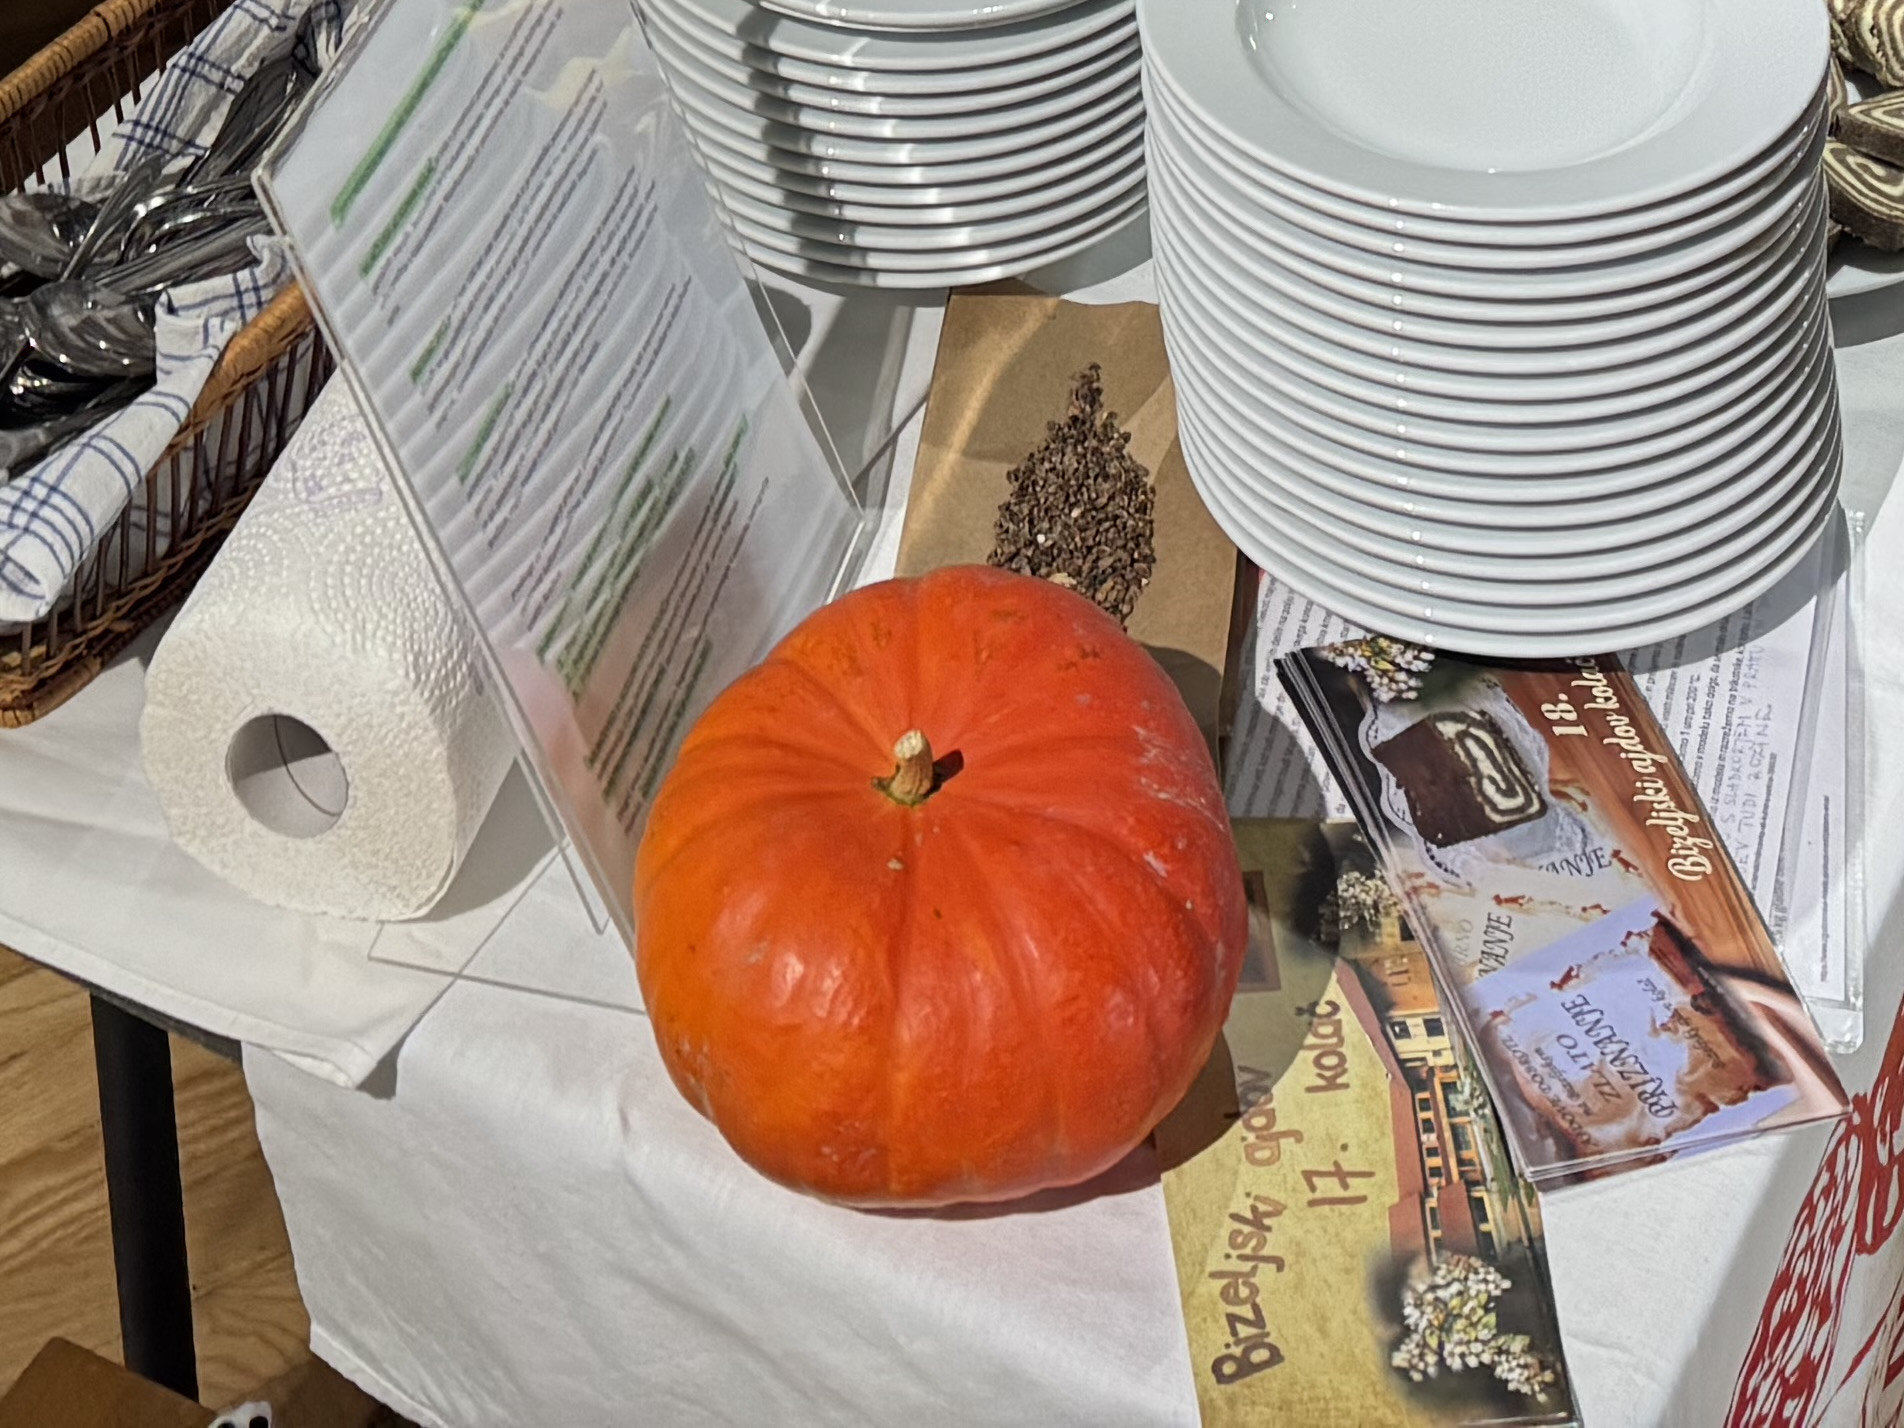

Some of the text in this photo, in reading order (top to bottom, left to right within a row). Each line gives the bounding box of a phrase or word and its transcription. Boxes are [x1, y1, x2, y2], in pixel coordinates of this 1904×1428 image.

[1541, 693, 1589, 737] 18.
[1603, 711, 1668, 774] ajdov
[1633, 776, 1714, 881] Bizeljski
[1737, 792, 1757, 833] TUDI
[1538, 846, 1612, 878] ANJE
[1475, 911, 1514, 980] NANJE
[1561, 994, 1679, 1119] PRIZNANJE
[1294, 999, 1377, 1208] 17. kolač
[1208, 1064, 1304, 1386] Bizeljski ajdov
